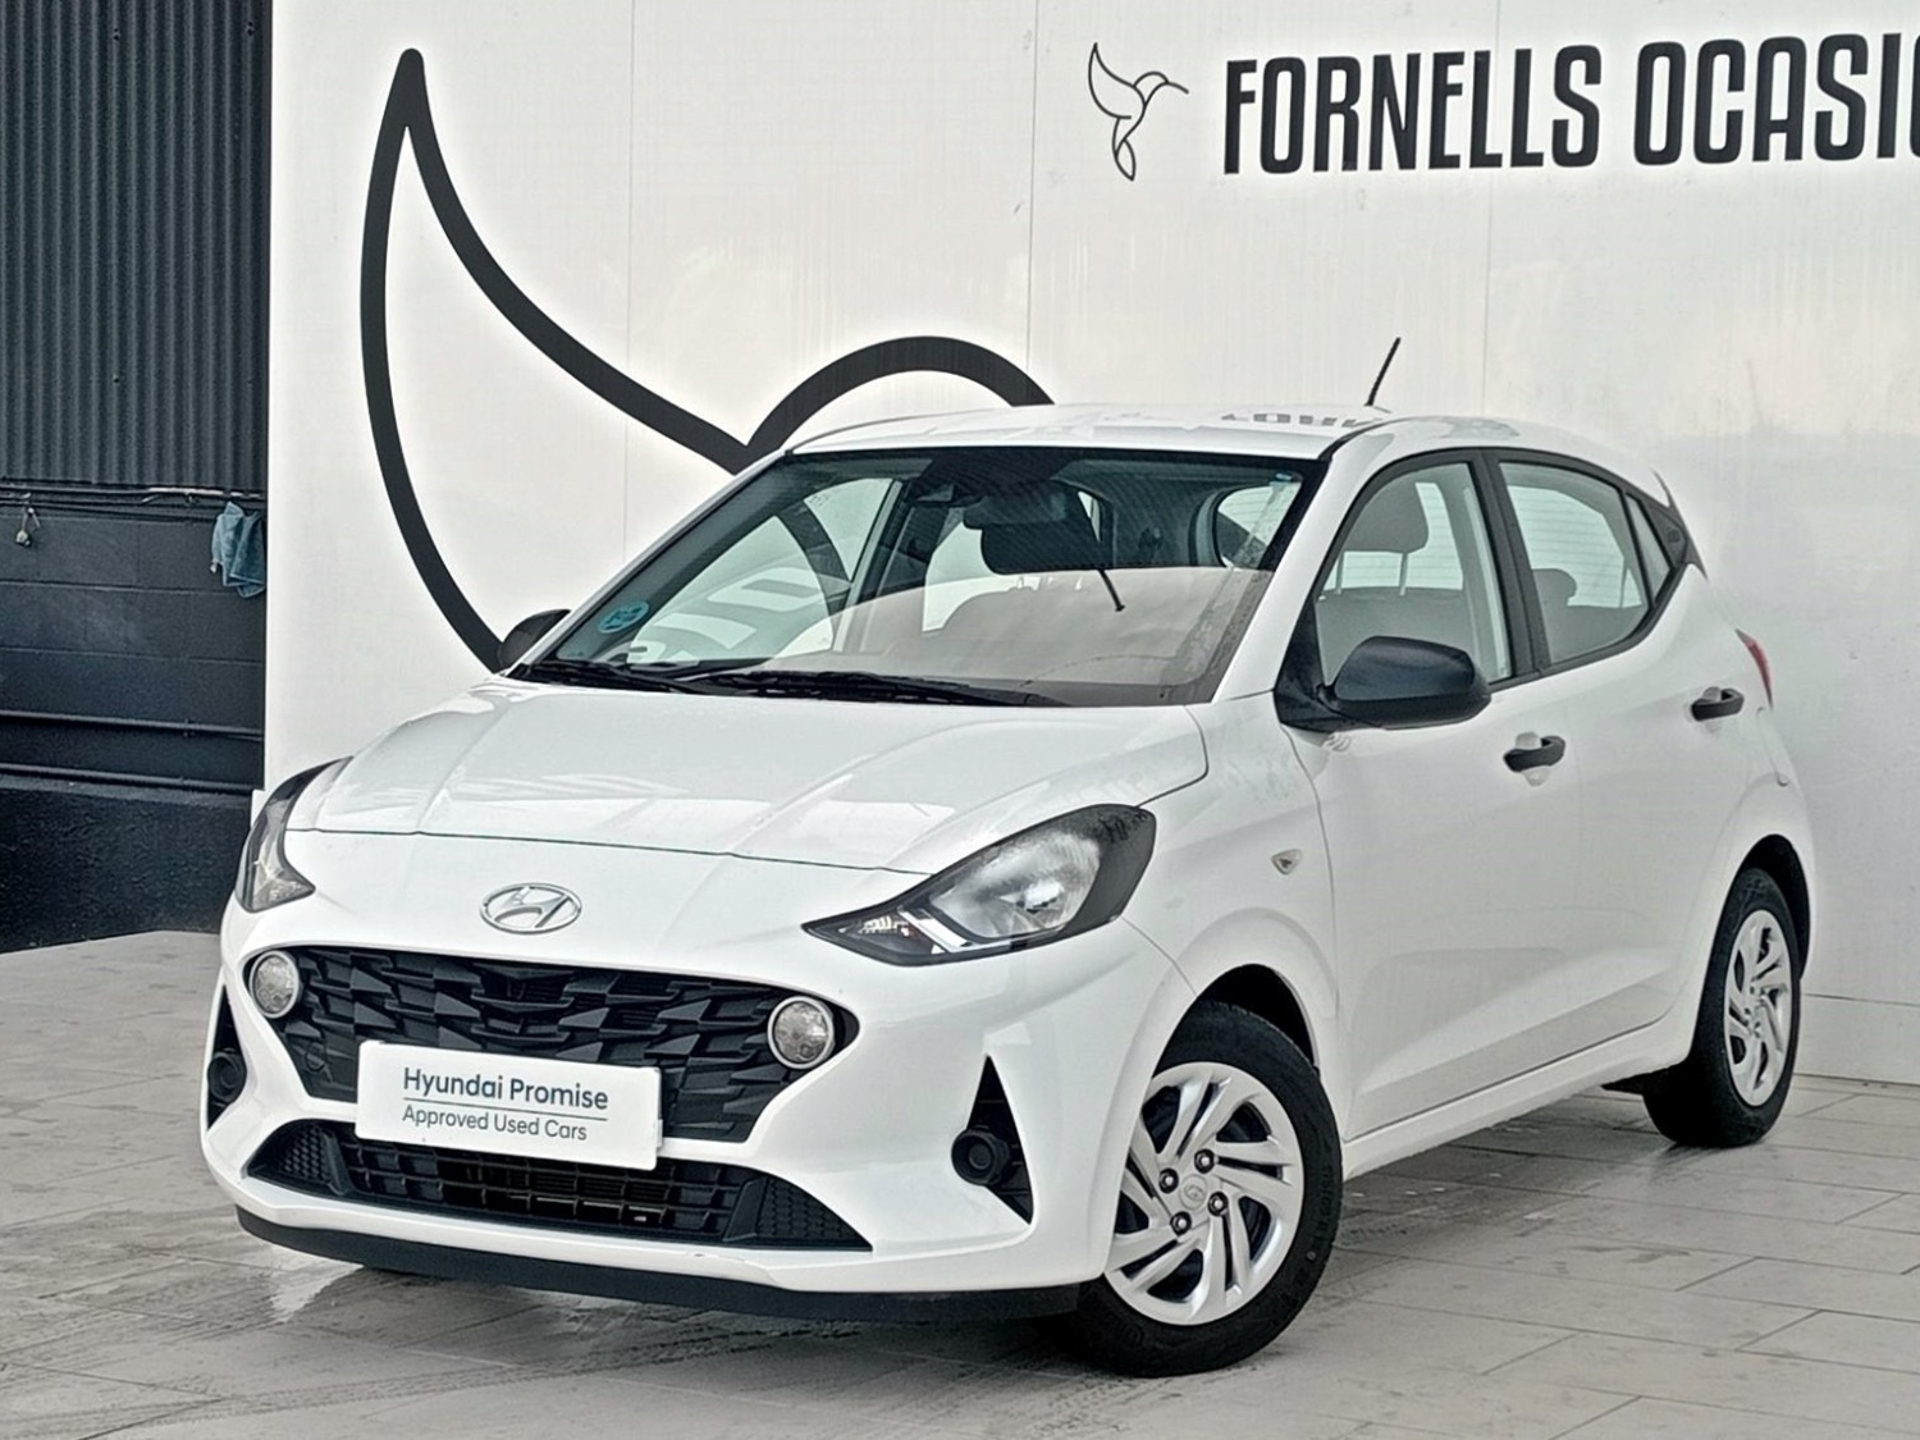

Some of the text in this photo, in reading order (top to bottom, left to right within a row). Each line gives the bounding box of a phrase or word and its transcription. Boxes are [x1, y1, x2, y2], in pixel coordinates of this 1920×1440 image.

[1224, 33, 1920, 175] FORNELLS OCASI
[403, 1067, 609, 1110] Hyundai Promise
[402, 1105, 588, 1140] Approved Used Cars
